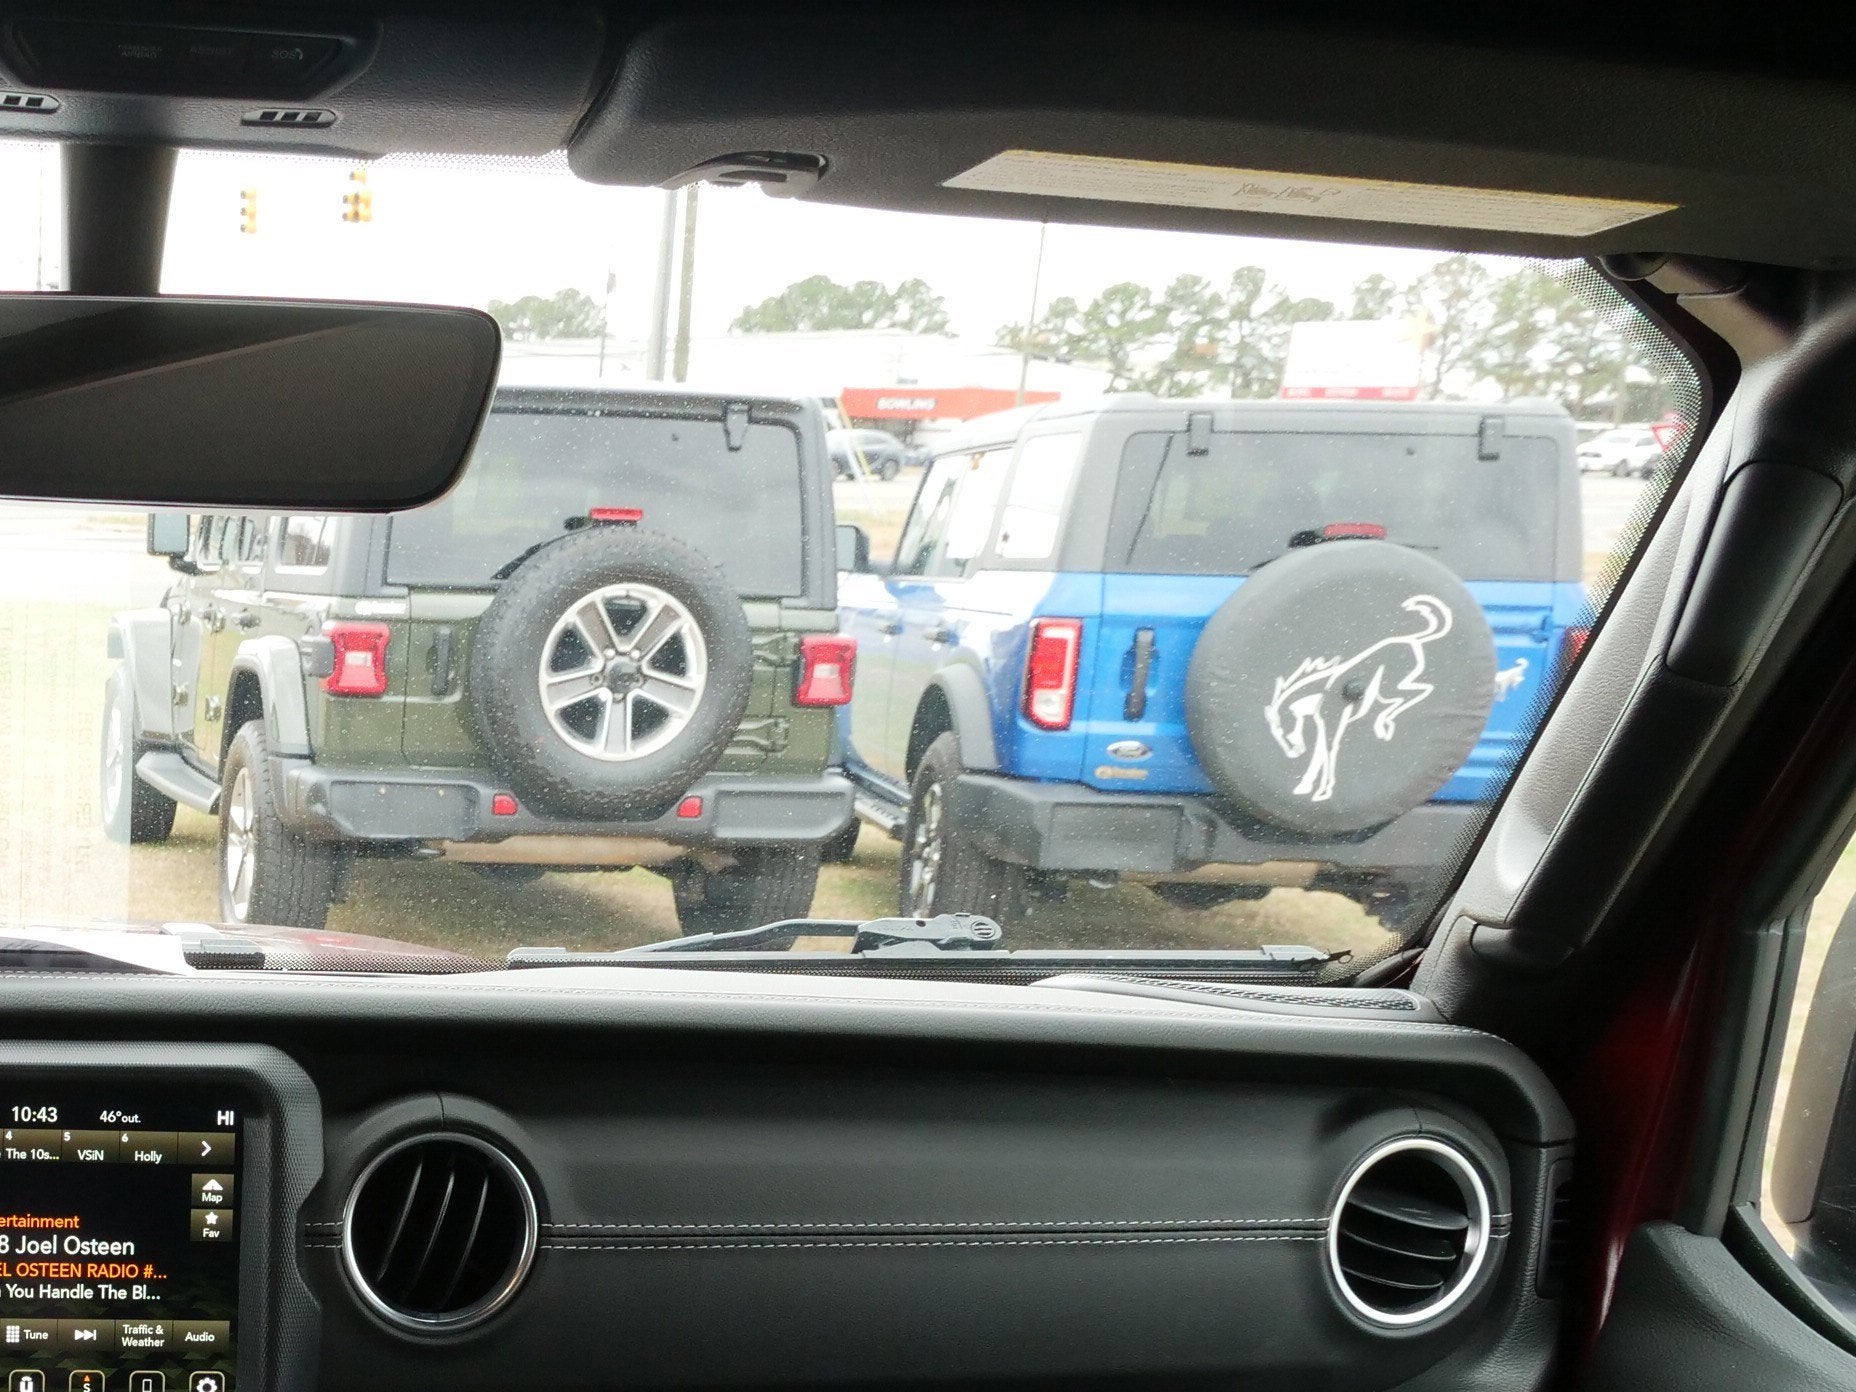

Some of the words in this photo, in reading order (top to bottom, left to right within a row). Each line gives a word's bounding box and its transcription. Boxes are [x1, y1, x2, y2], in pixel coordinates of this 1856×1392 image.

[876, 397, 937, 411] BOWLING
[11, 1106, 58, 1122] 10:43
[217, 1110, 234, 1125] HI
[5, 1130, 12, 1140] 4
[64, 1132, 71, 1141] 5
[121, 1133, 129, 1142] 6
[5, 1148, 26, 1160] The
[78, 1150, 104, 1161] VSiN
[134, 1150, 162, 1164] Holly
[201, 1193, 223, 1203] Map
[203, 1228, 220, 1238] Fav
[15, 1234, 57, 1255] Joel
[63, 1235, 134, 1255] Osteen
[16, 1262, 81, 1278] OSTEEN
[87, 1263, 138, 1278] RADIO
[5, 1283, 34, 1299] You
[39, 1284, 94, 1299] Handle
[98, 1284, 127, 1299] The
[23, 1330, 48, 1340] Tune
[122, 1324, 153, 1335] Traffic
[155, 1325, 164, 1335] &
[122, 1336, 164, 1347] Weather
[185, 1332, 215, 1342] Audio
[83, 1383, 91, 1392] S
